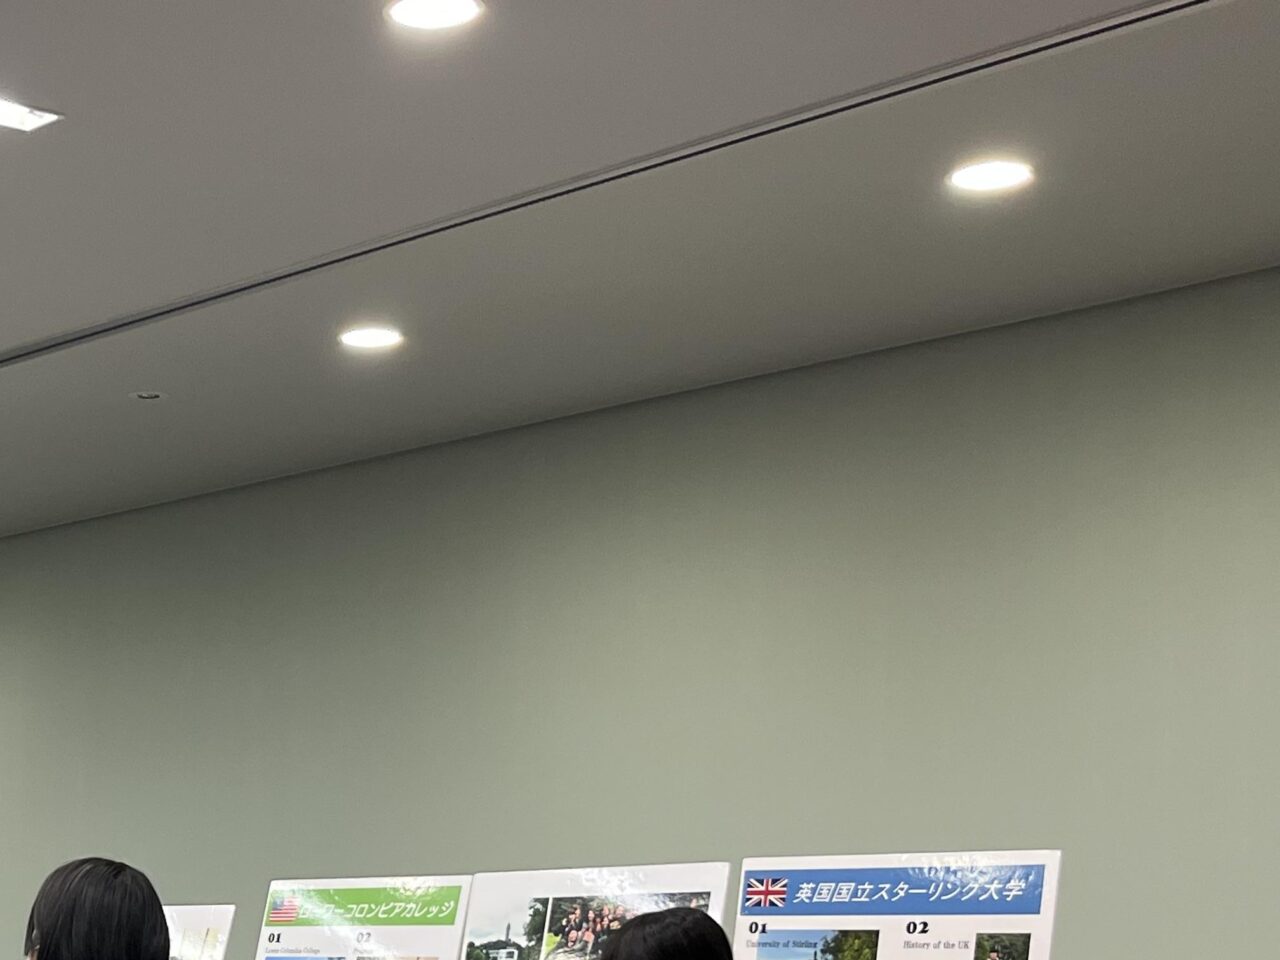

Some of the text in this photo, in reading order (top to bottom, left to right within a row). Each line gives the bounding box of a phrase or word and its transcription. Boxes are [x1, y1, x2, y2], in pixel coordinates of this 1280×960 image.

[793, 881, 1026, 903] 英国国立スターリング大学
[748, 921, 768, 934] 01
[906, 921, 930, 935] 02
[268, 932, 282, 944] 01
[903, 940, 970, 950] History of the UK
